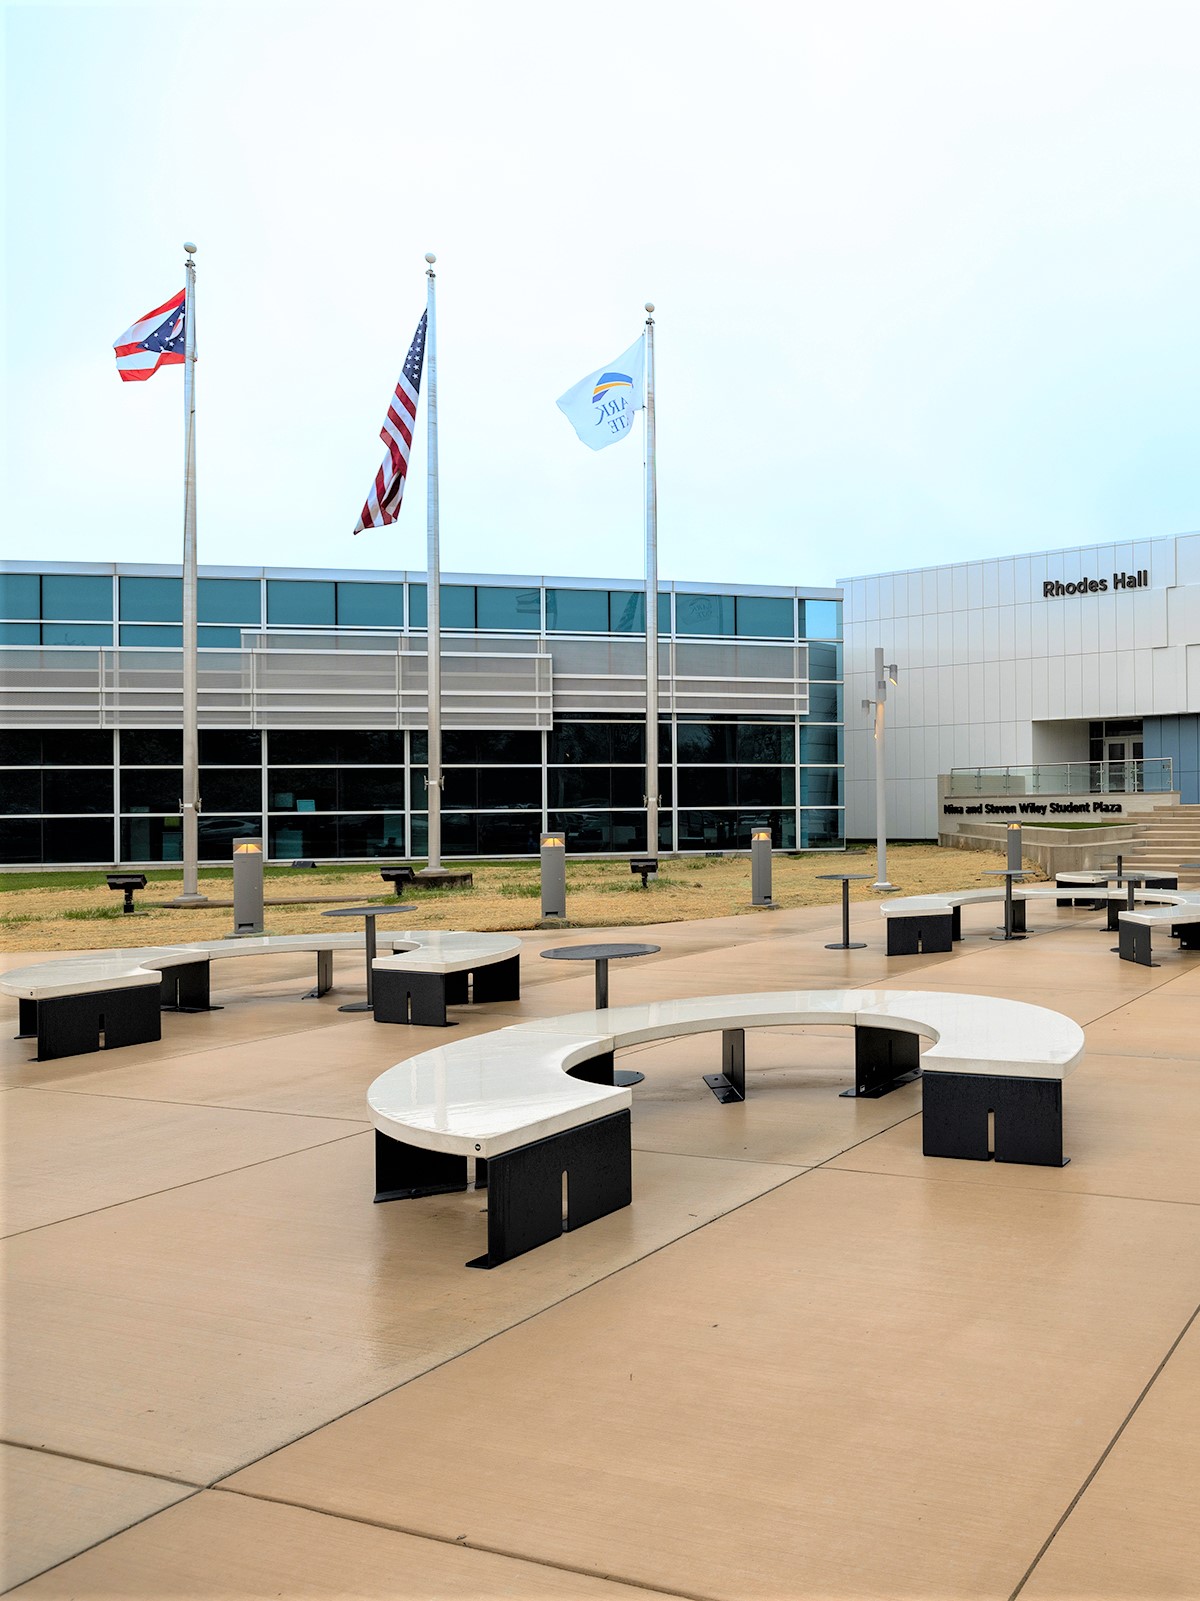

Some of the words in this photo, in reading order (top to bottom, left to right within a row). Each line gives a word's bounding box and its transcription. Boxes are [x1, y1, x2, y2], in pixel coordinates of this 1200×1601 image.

[1043, 577, 1108, 597] Rhodes
[1113, 570, 1148, 590] Hall
[966, 803, 983, 814] and
[985, 804, 1017, 814] Steven
[1018, 803, 1047, 815] Wiley
[1050, 802, 1090, 813] Student
[1093, 802, 1122, 813] Plaza
